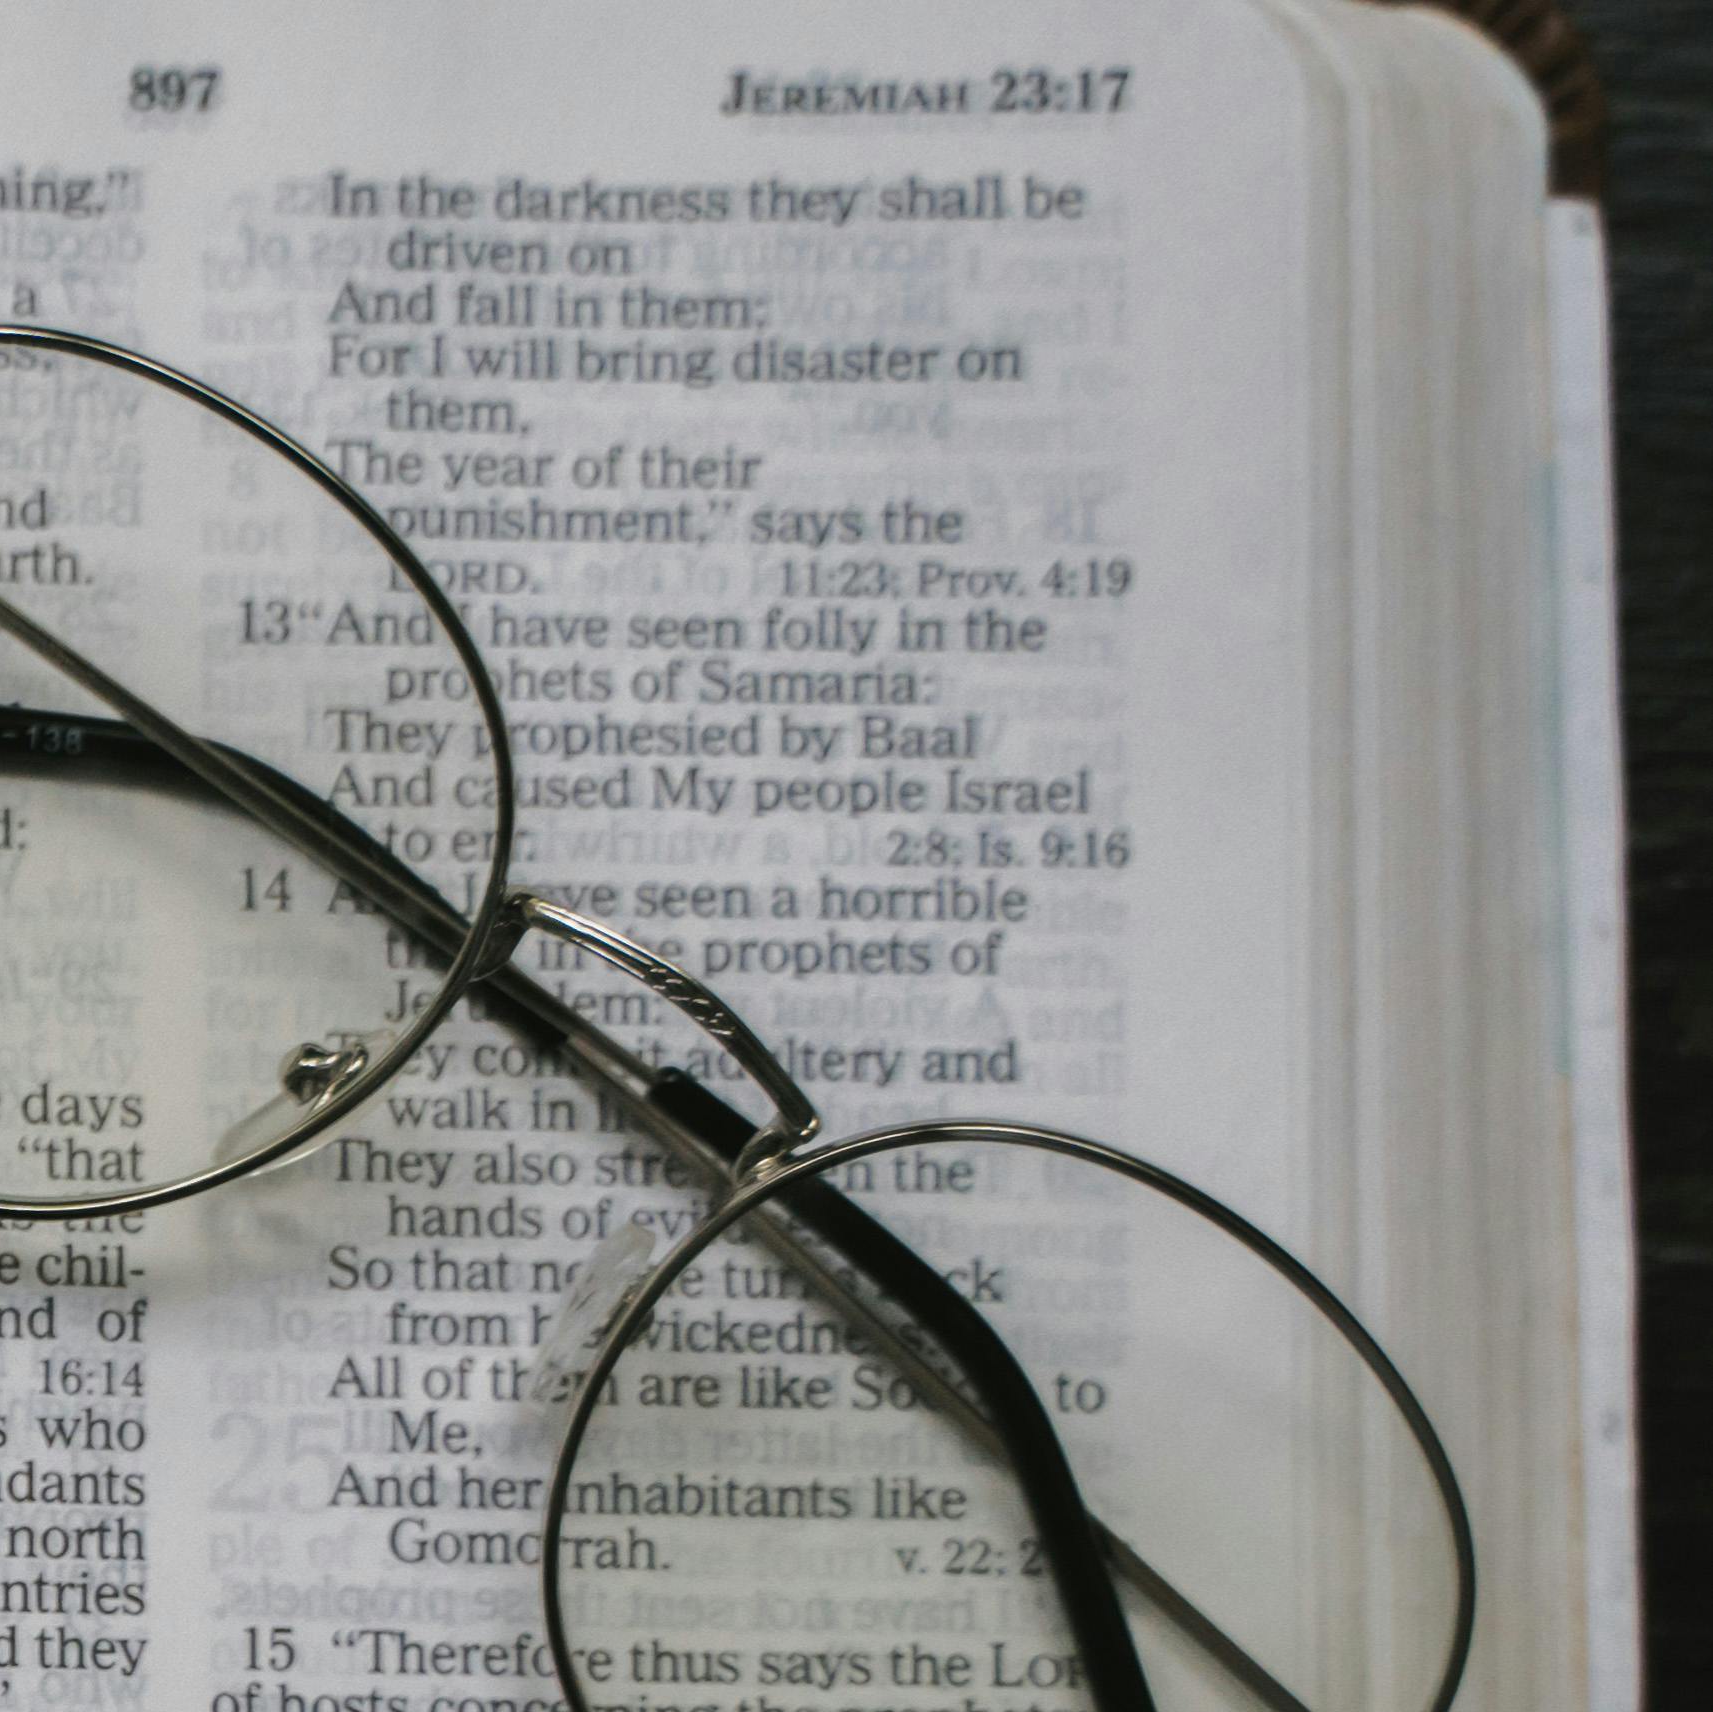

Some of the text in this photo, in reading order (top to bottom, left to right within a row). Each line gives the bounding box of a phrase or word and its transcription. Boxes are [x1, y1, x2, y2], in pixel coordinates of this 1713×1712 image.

[130, 69, 220, 116] 897
[721, 69, 1131, 117] JEREMIAH 23:17
[329, 174, 1083, 234] In the darkness they shall be
[916, 563, 1026, 603] Prov.
[1041, 561, 1132, 601] 4:19
[39, 1357, 145, 1397] 16:14
